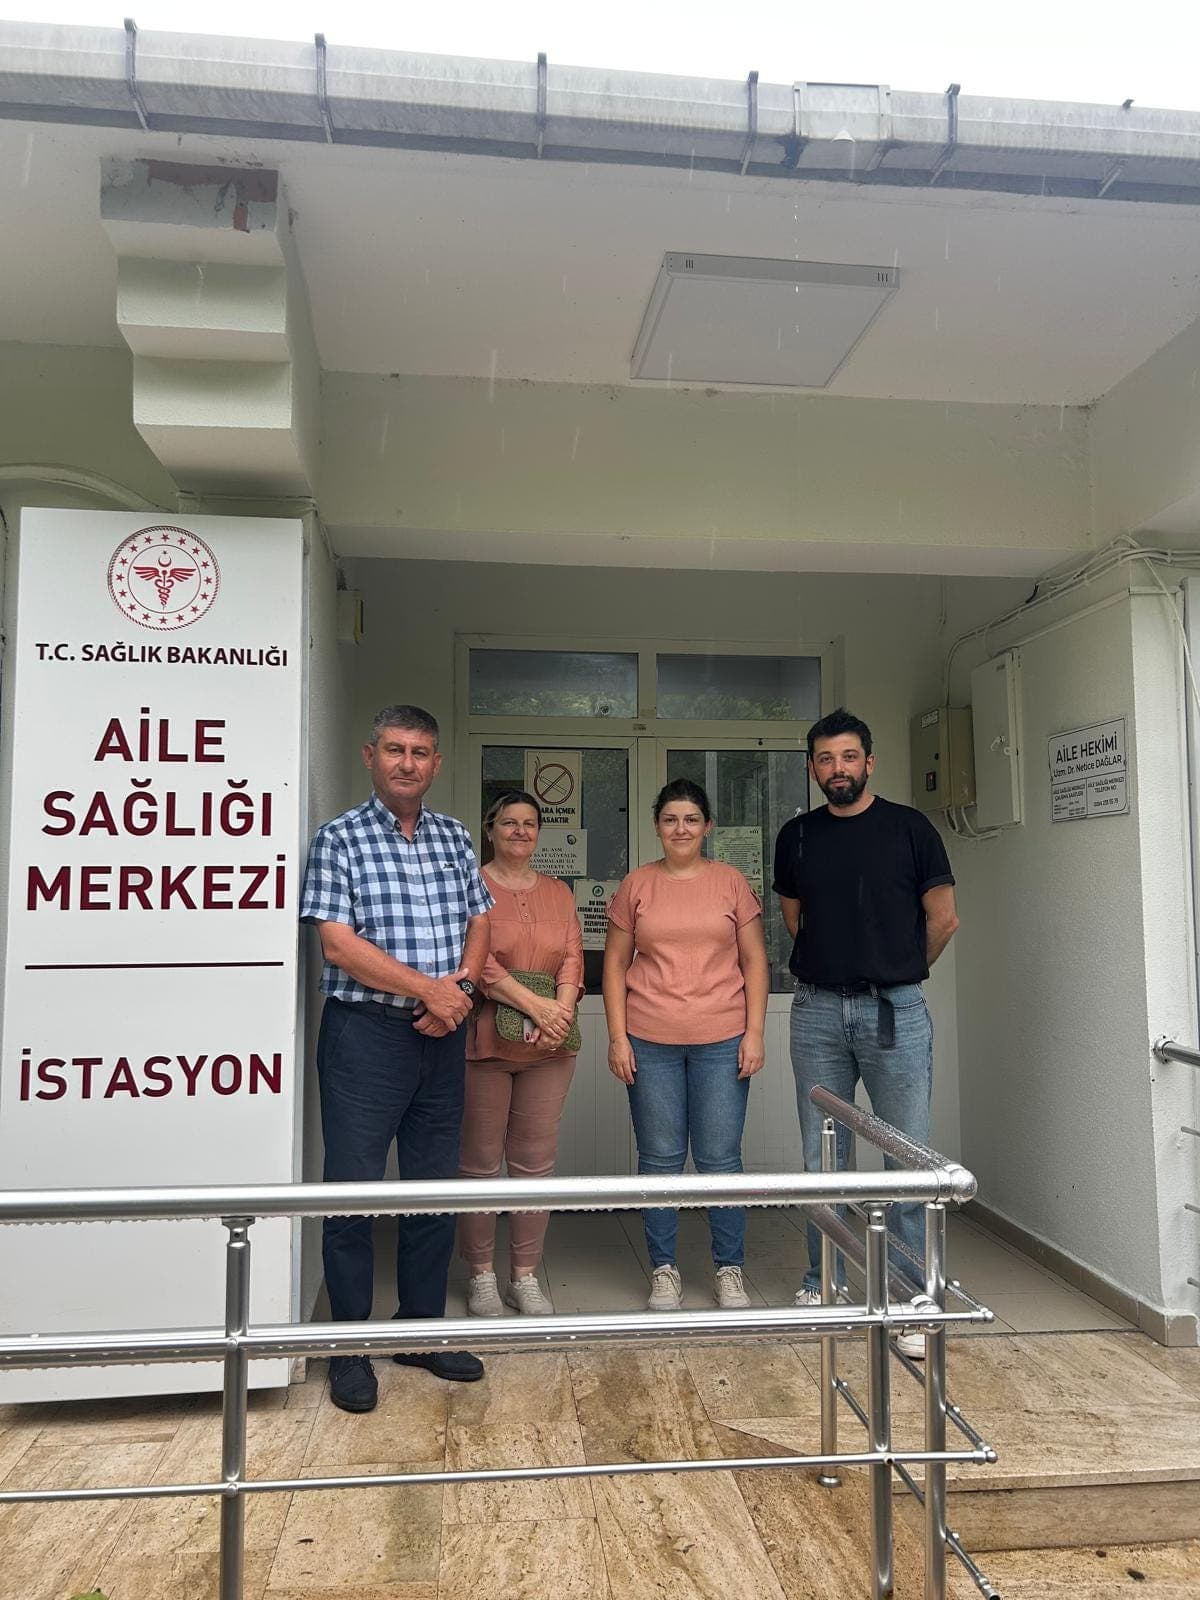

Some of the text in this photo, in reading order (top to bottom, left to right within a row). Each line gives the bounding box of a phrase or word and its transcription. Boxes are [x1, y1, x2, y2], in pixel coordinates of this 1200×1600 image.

[35, 641, 288, 667] T.C. SAĞLIK BAKANLIĞI
[94, 706, 227, 763] AİLE
[1056, 731, 1118, 764] AİLE HEKİMİ
[1095, 754, 1122, 769] DAĞLAR
[42, 778, 273, 837] SAĞLIĞI
[542, 816, 569, 824] ASAKTIR
[555, 806, 576, 816] İÇMEK
[26, 854, 287, 911] MERKEZİ
[20, 1048, 282, 1101] İSTASYON
